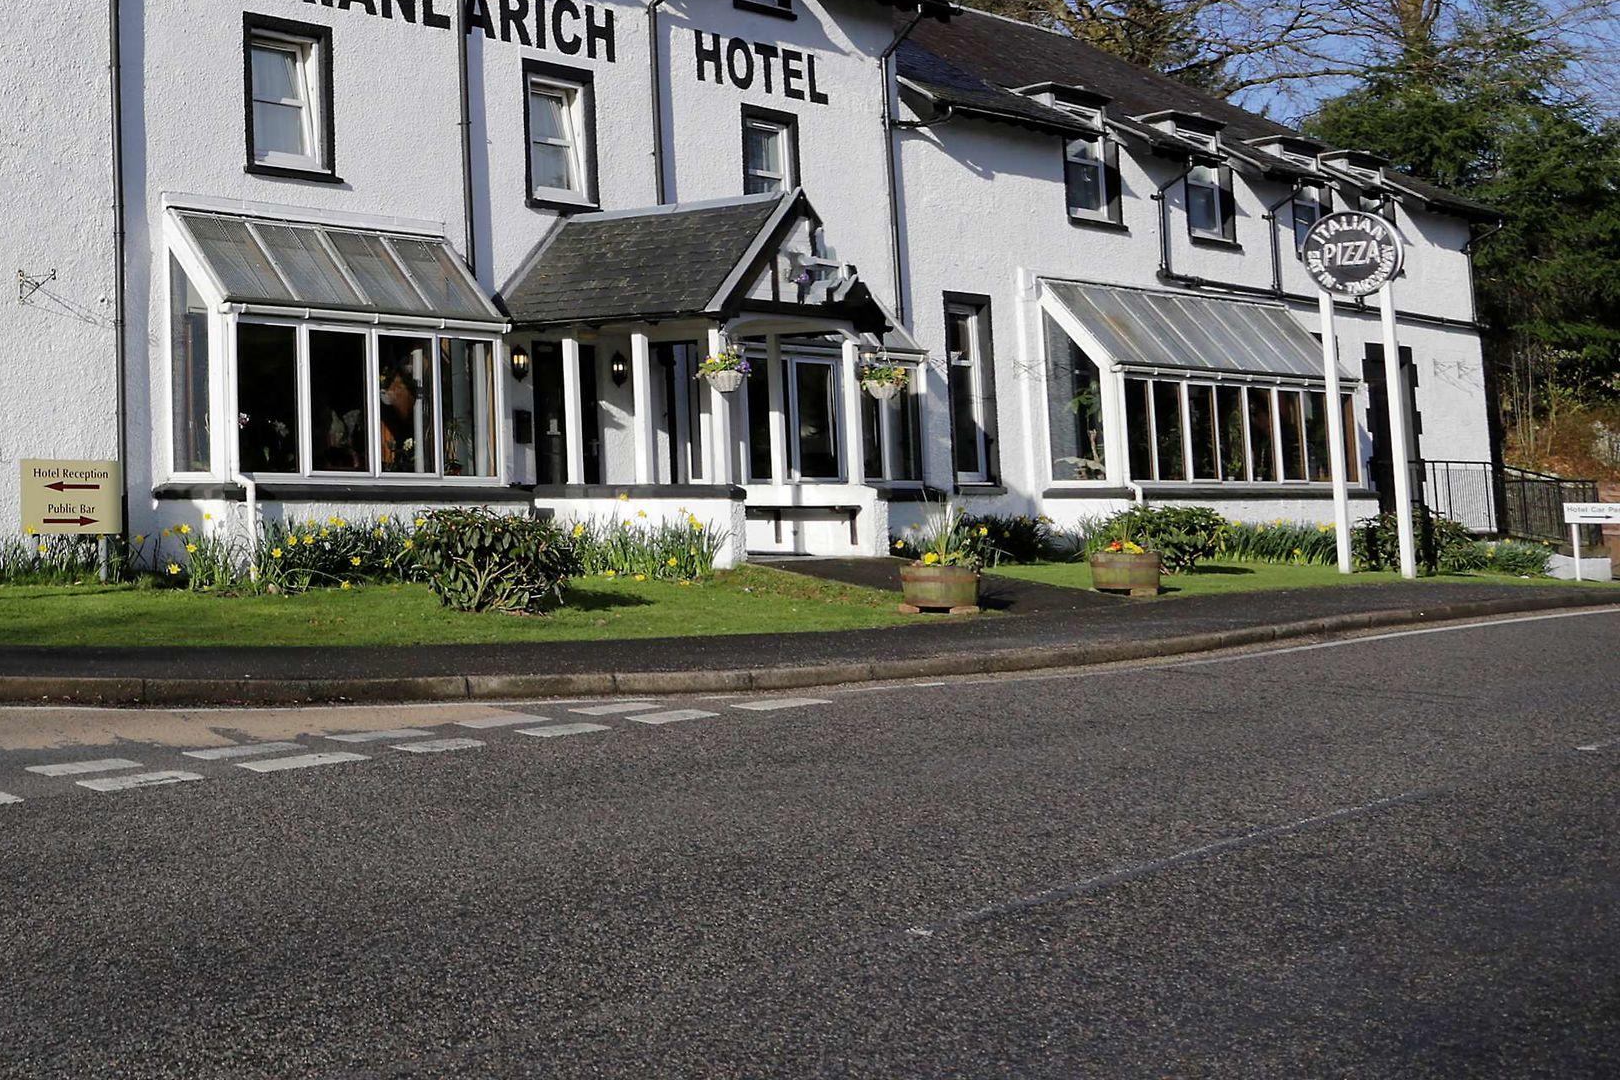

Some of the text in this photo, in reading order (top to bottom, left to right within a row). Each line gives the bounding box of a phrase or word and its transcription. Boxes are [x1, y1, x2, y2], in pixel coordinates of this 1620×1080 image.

[694, 29, 829, 105] HOTEL
[1311, 215, 1387, 245] ITALIAN
[1307, 251, 1326, 273] EAT
[1323, 239, 1381, 268] PIZZA
[33, 468, 109, 481] Hotel Reception
[48, 503, 96, 514] Public Bar
